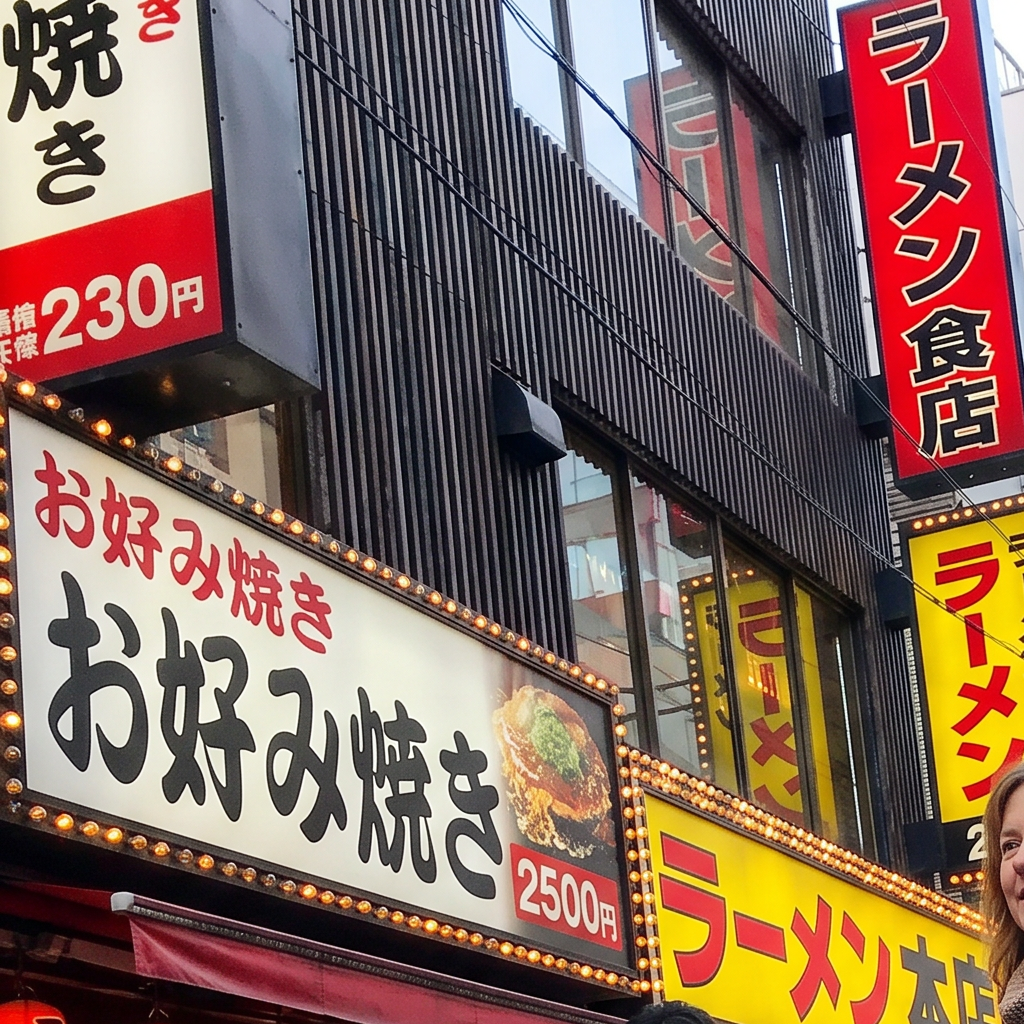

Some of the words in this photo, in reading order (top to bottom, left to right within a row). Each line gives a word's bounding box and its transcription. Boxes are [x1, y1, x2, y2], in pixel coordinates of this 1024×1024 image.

[3, 0, 122, 206] 焼き
[41, 262, 205, 355] 230円
[868, 0, 1000, 460] ラーメン食店
[34, 450, 334, 653] お好み焼き
[47, 570, 503, 900] お好み焼き
[515, 857, 619, 943] 2500円
